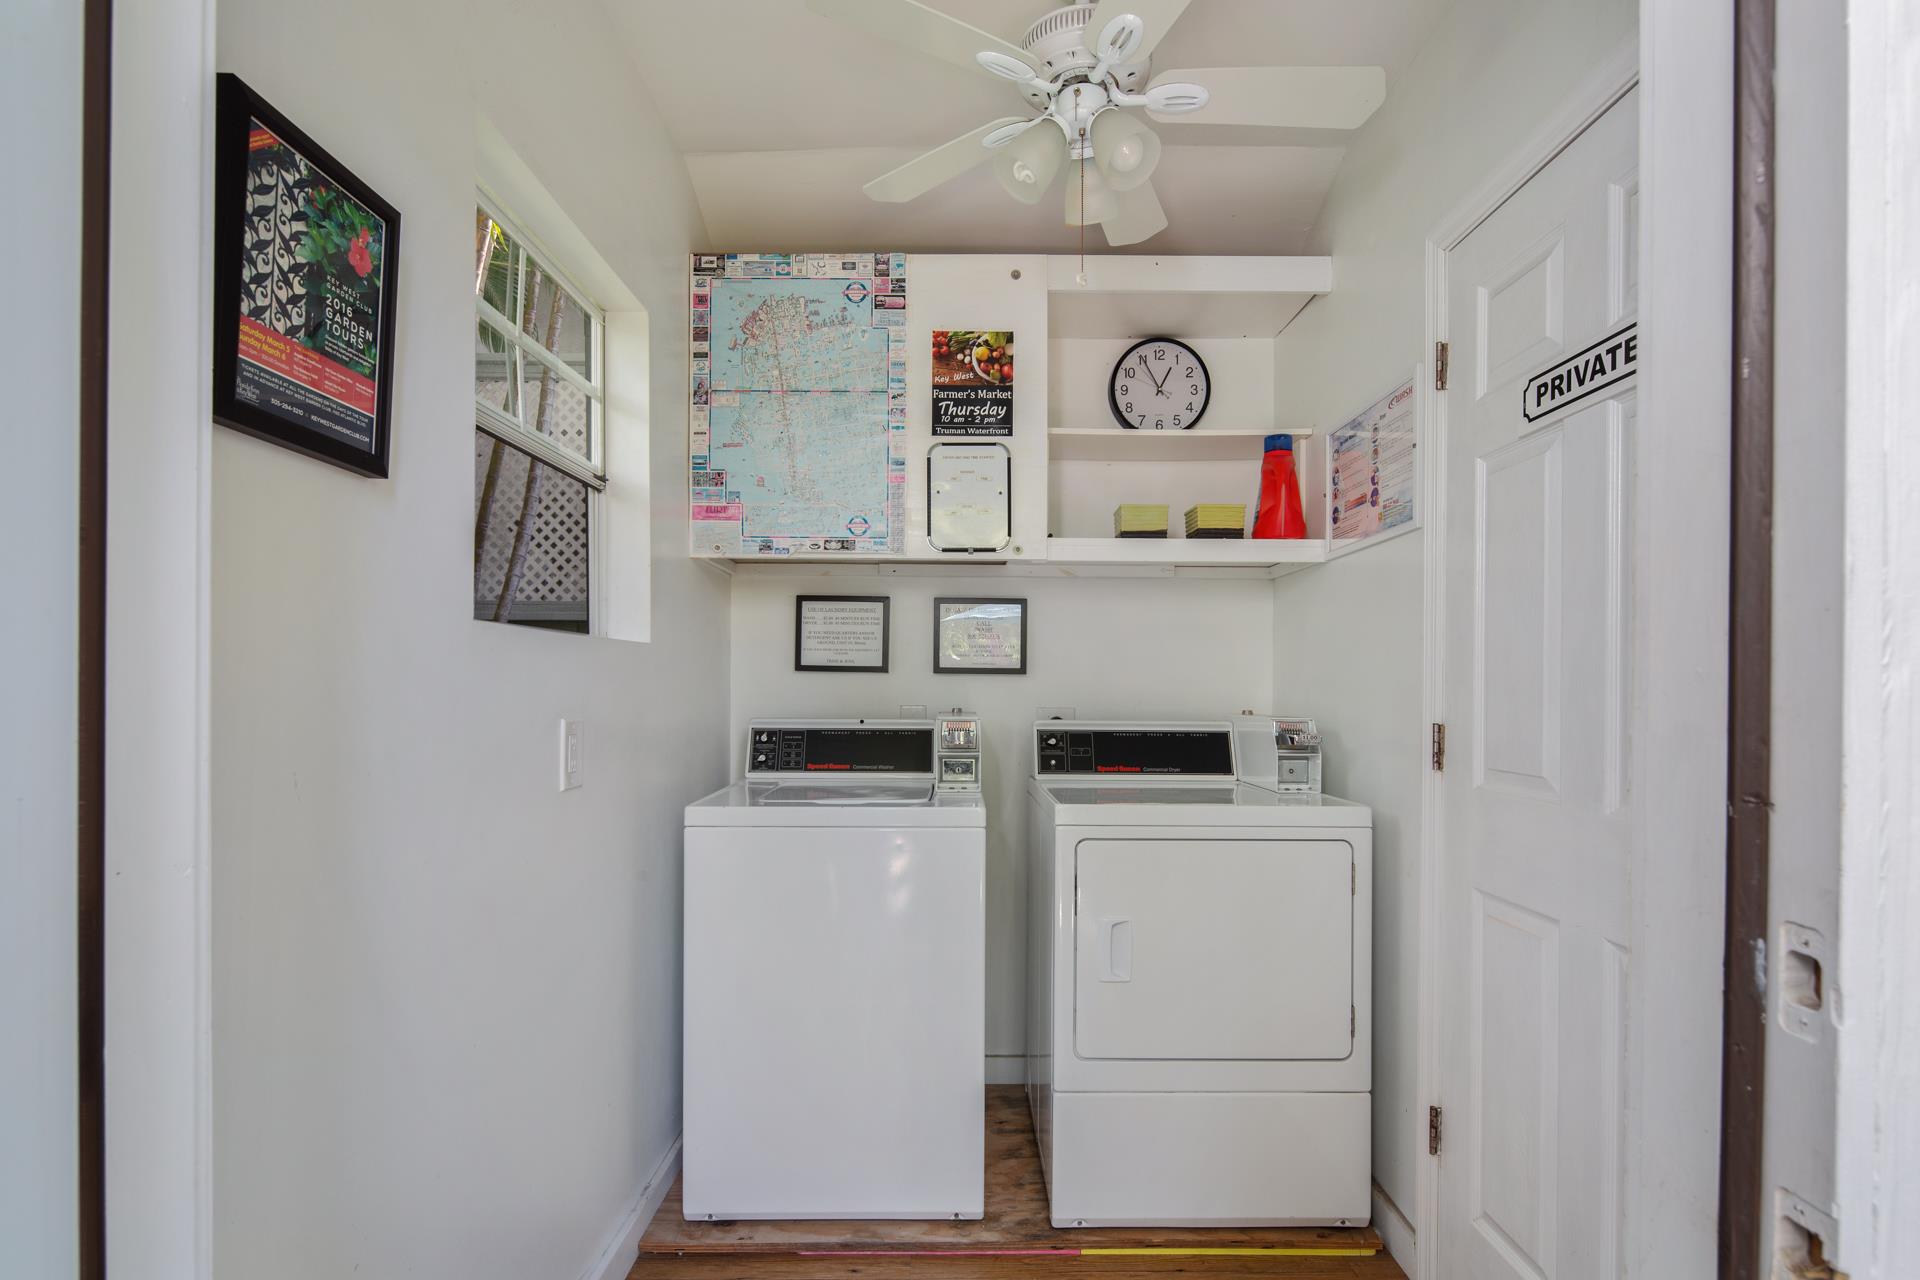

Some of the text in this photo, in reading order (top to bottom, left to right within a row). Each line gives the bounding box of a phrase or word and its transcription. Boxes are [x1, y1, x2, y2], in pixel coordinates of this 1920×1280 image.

[327, 274, 360, 299] KEY WEST
[327, 283, 372, 314] GARDEN CLUB
[326, 294, 352, 318] 2016
[326, 307, 372, 342] GARDEN
[325, 320, 364, 349] TOURS
[1154, 350, 1165, 360] 12
[1176, 354, 1179, 366] 1
[954, 372, 974, 381] West
[1124, 368, 1136, 378] 10
[1186, 366, 1194, 378] 2
[1536, 334, 1637, 408] PRIVATE
[933, 389, 1012, 399] Farmer's Market
[1120, 384, 1128, 396] 9
[1190, 384, 1198, 396] 3
[938, 401, 1006, 419] Thursday
[1125, 402, 1133, 413] 8
[1186, 402, 1194, 413] 4
[1138, 415, 1146, 426] 7
[1156, 420, 1164, 430] 6
[1173, 414, 1180, 426] 5
[311, 415, 369, 442] KEYWESTGARDENCLUB.COM
